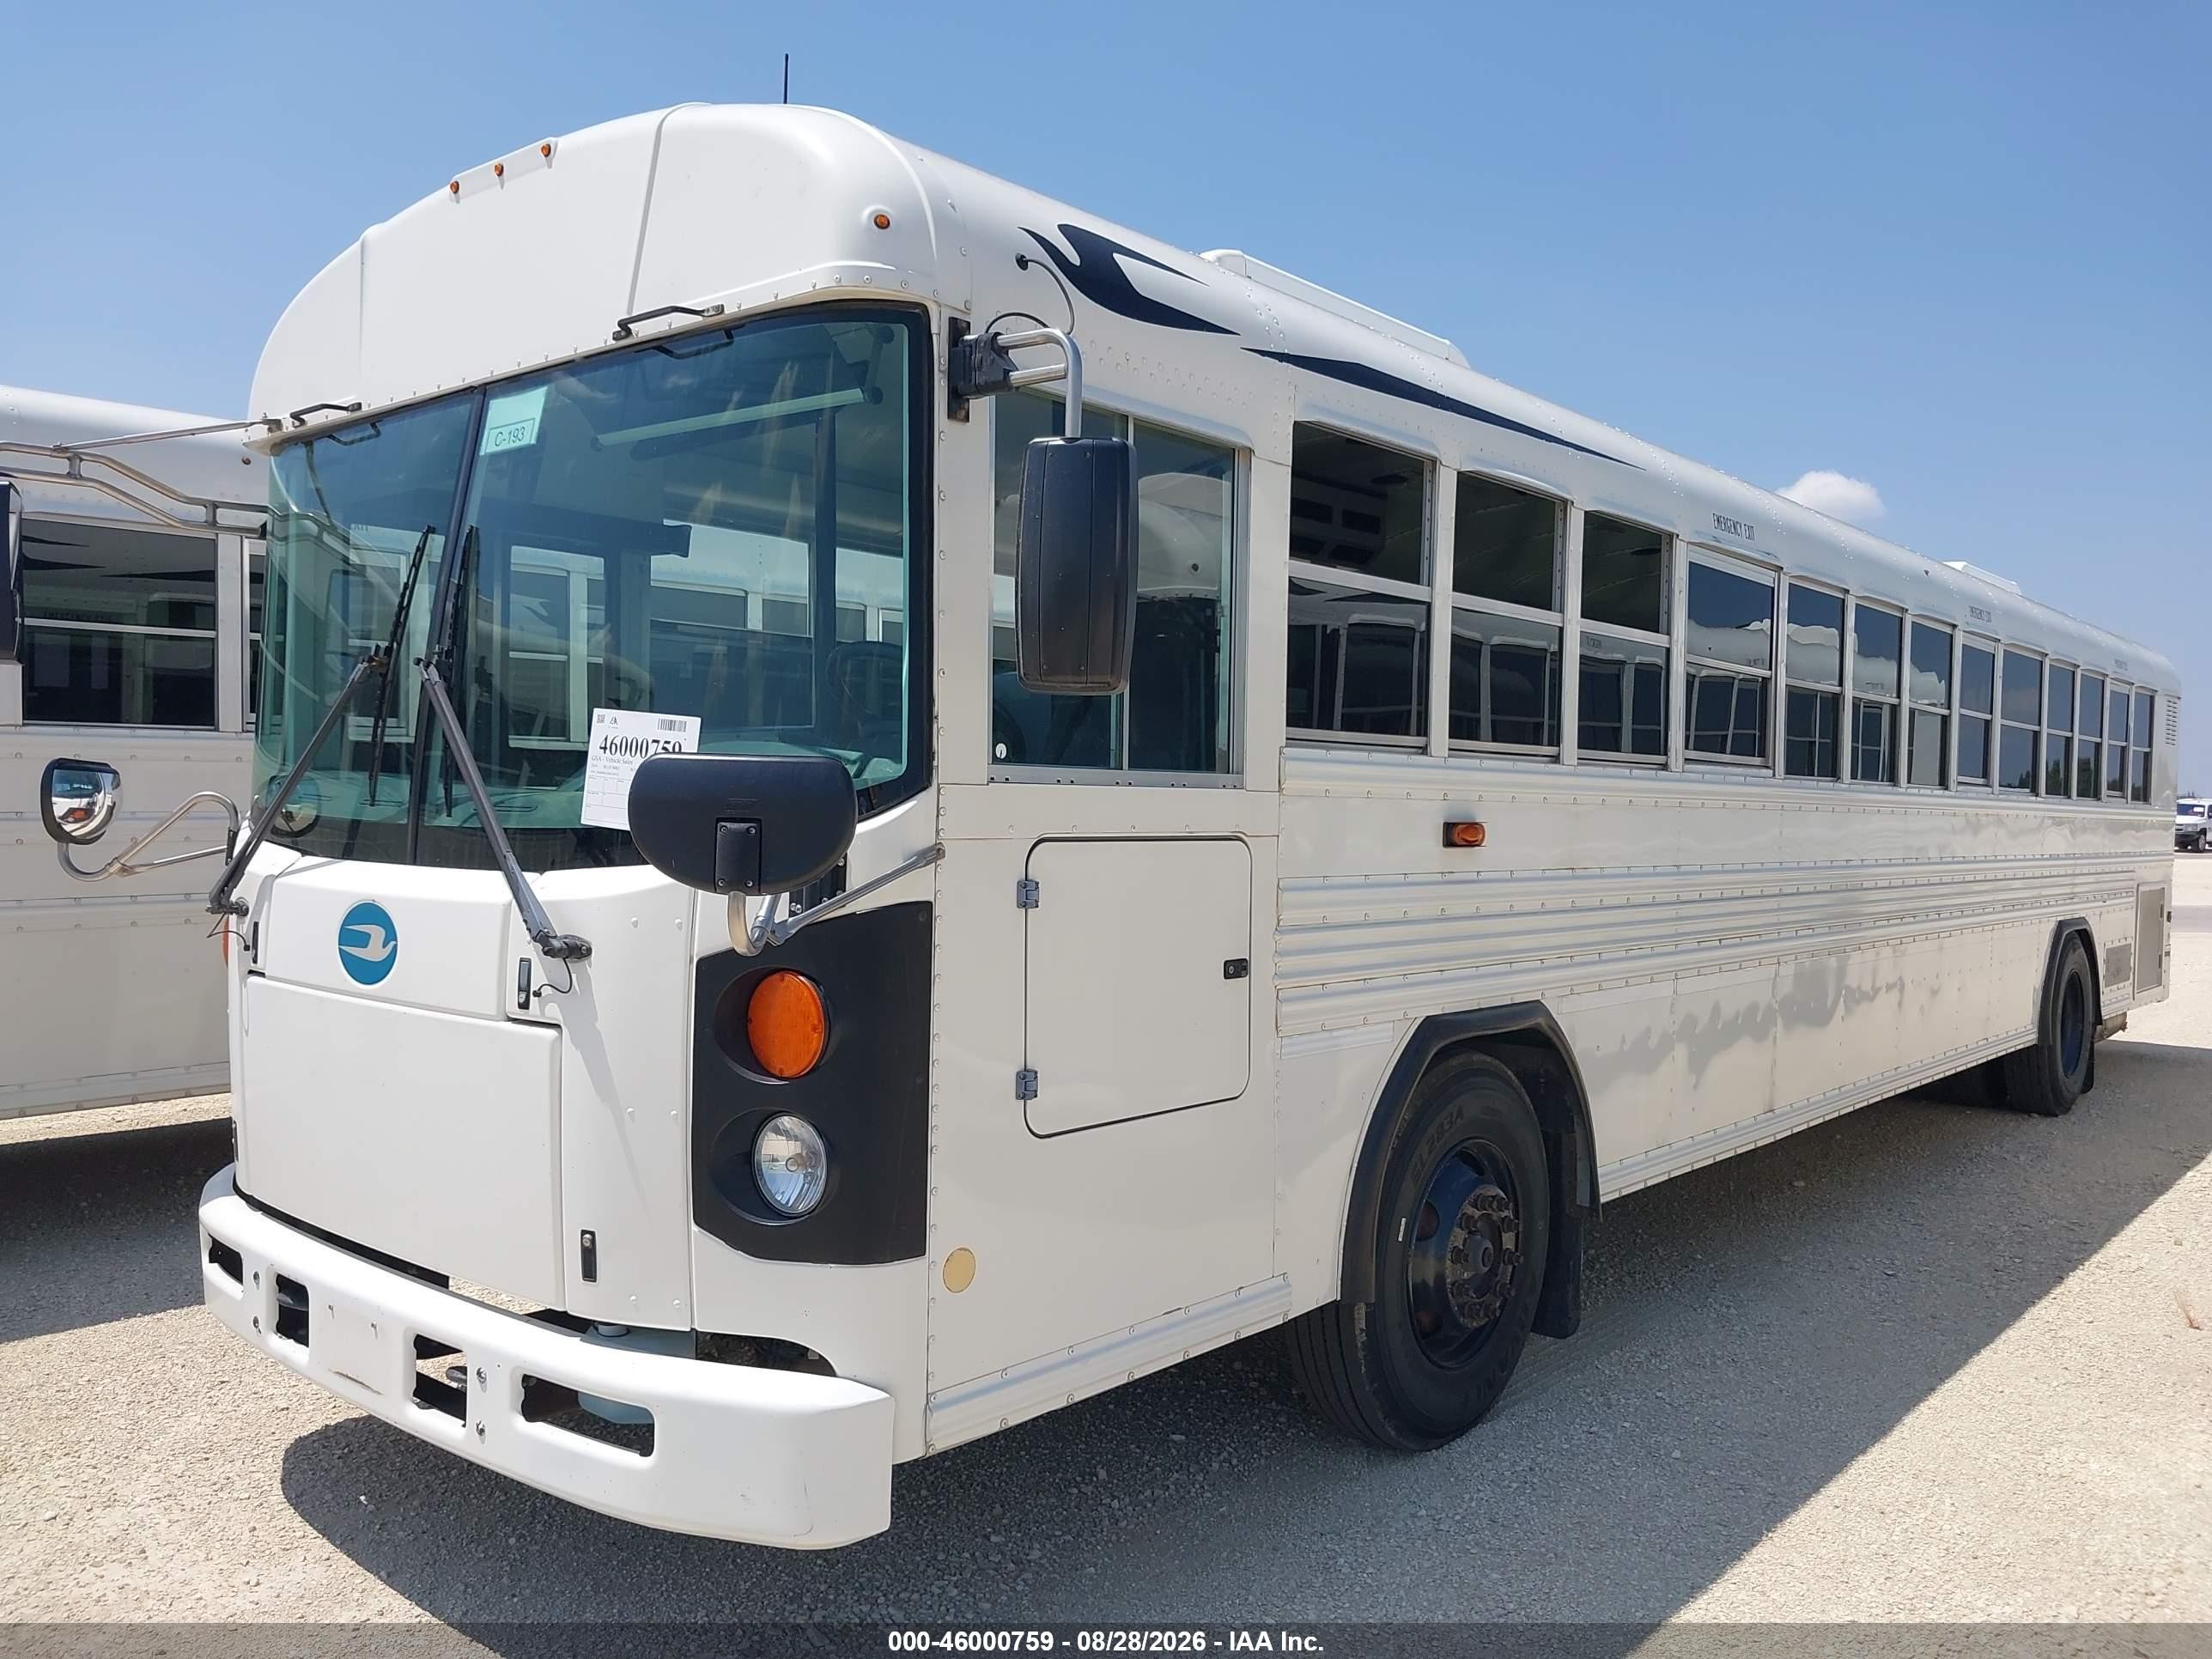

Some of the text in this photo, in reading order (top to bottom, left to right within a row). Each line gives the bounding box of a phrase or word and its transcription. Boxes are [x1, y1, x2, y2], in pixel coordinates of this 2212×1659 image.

[495, 426, 526, 447] C-193
[1712, 513, 1755, 541] EMERGENCY EXIT
